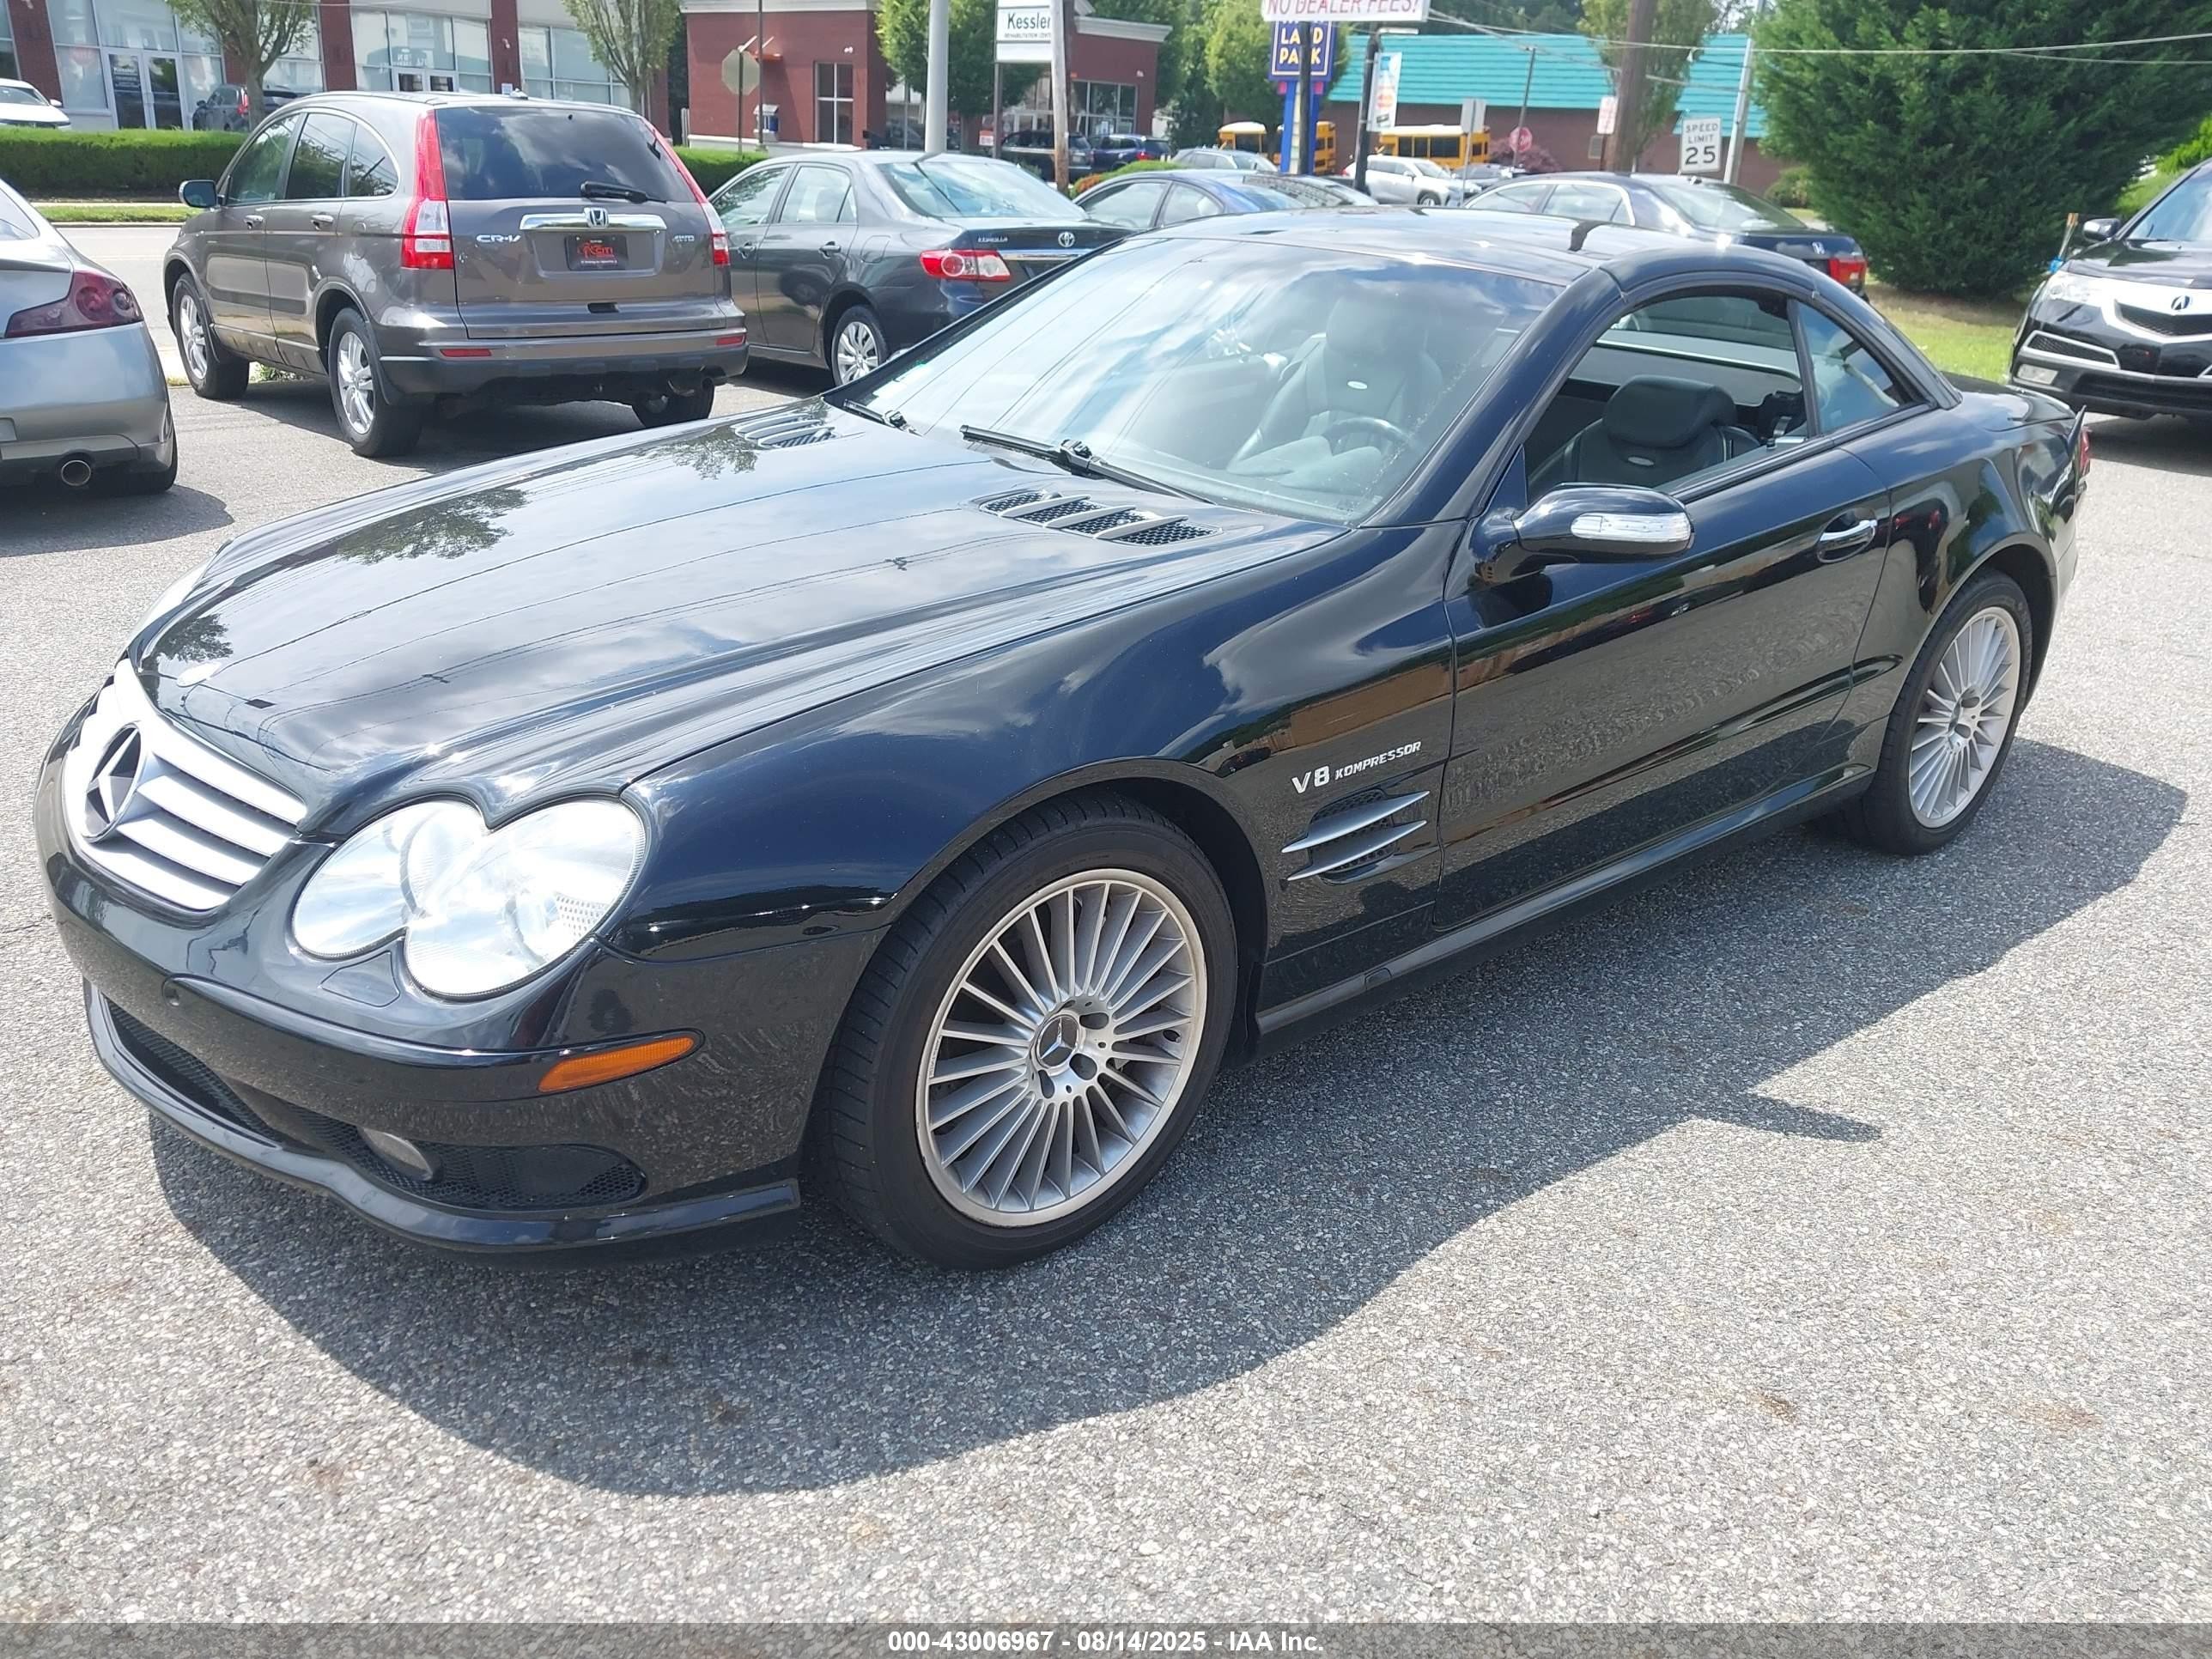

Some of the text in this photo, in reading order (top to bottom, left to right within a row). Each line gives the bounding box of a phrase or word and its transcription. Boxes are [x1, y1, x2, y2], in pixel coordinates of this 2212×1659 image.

[1267, 0, 1290, 14] NO
[1296, 0, 1361, 14] DEALER
[1280, 27, 1324, 45] LAD
[1279, 46, 1322, 64] PAK
[1686, 123, 1718, 133] SPEED
[1688, 134, 1713, 144] LIMIT
[1686, 145, 1716, 165] 25
[1291, 741, 1421, 794] V8 KOMPRESSOR
